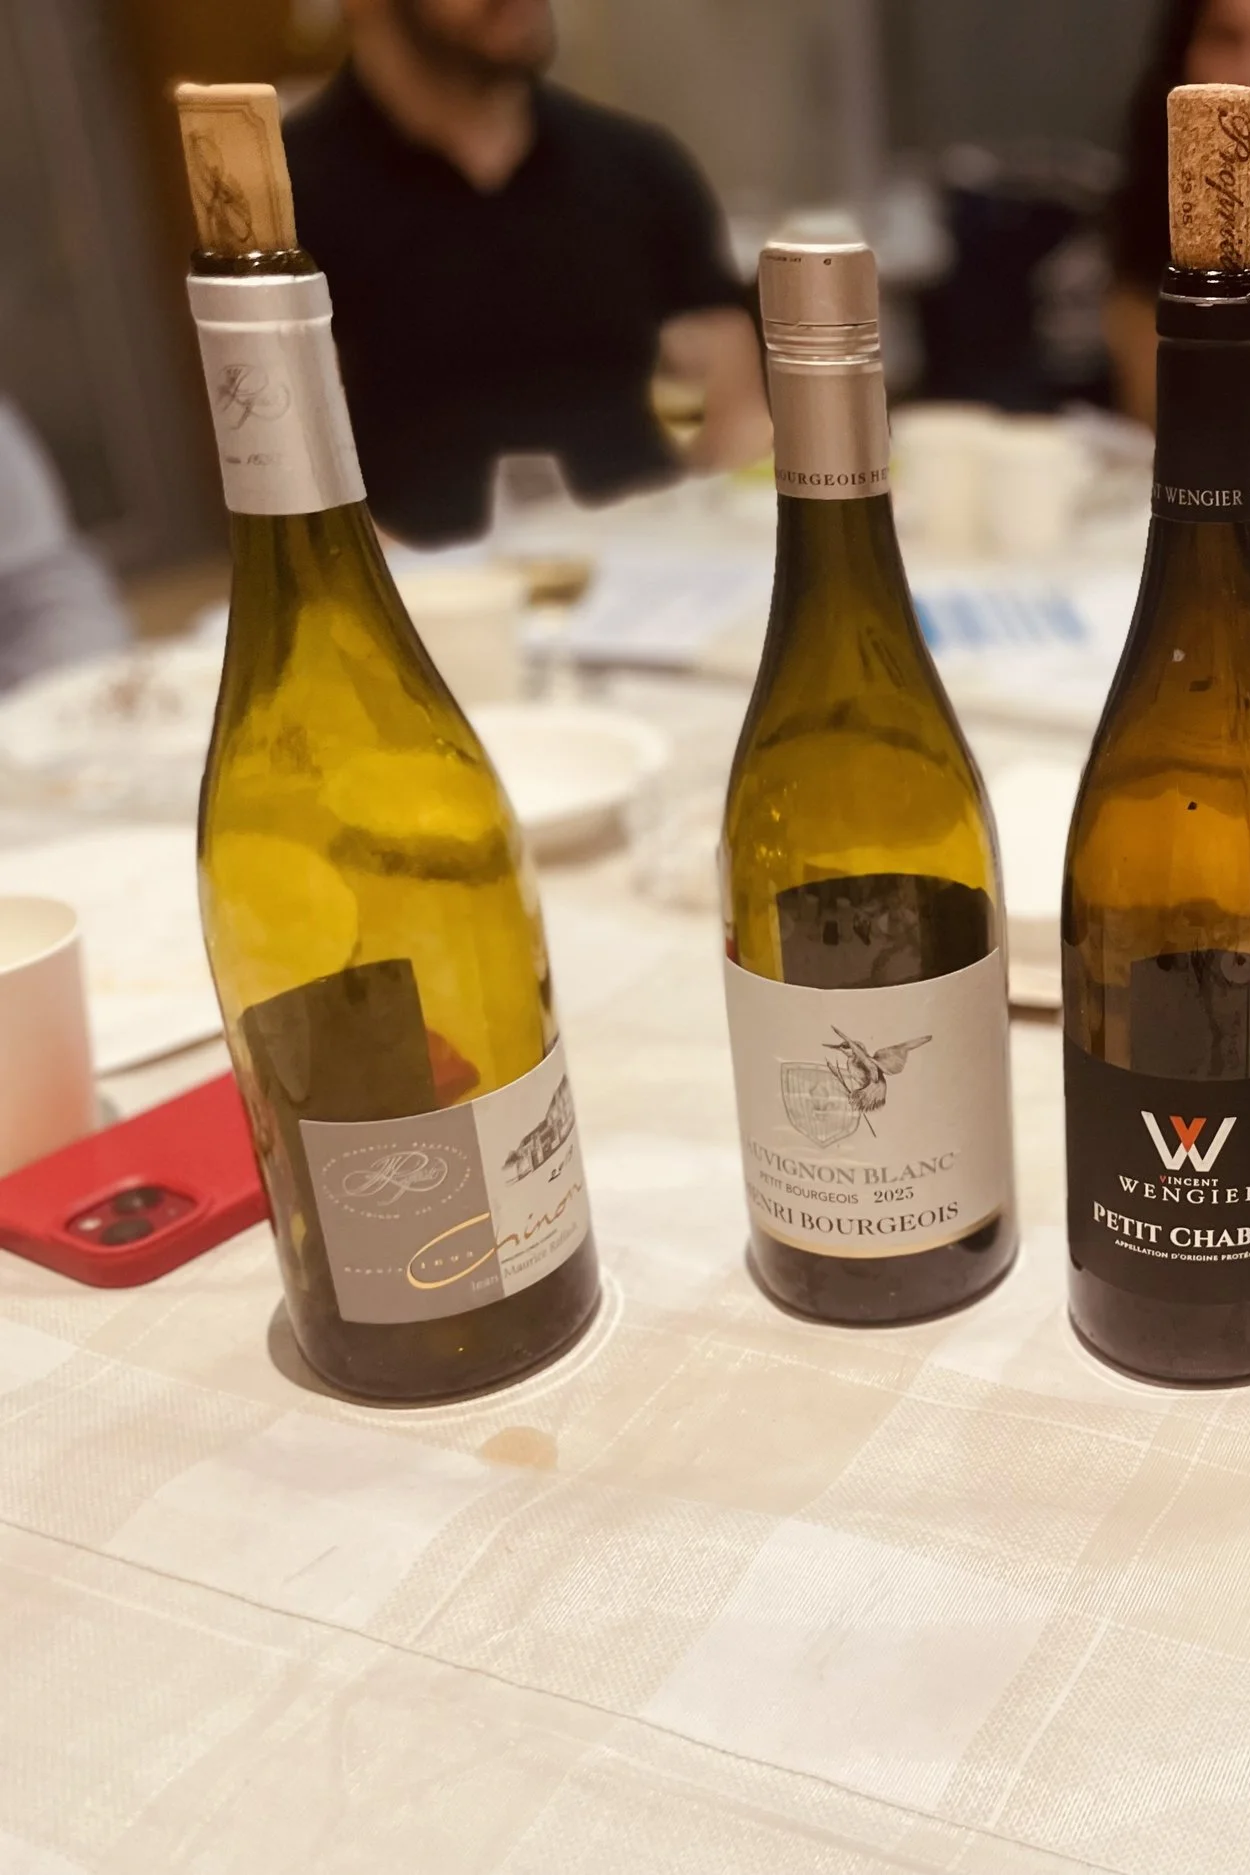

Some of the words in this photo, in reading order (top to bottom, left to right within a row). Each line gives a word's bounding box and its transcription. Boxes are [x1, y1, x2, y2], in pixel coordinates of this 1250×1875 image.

[777, 468, 866, 487] OURGEOIS
[1164, 485, 1244, 507] WENGIER
[863, 1152, 955, 1186] BLANC
[1159, 1174, 1219, 1188] VINCENT
[759, 1171, 784, 1190] PETIT
[785, 1183, 859, 1205] BOURGEOIS
[799, 1201, 960, 1236] BOURGEOIS
[1093, 1201, 1163, 1244] PETIT
[1114, 1239, 1169, 1260] APPELLATION
[1170, 1251, 1219, 1263] D'ORIGINE
